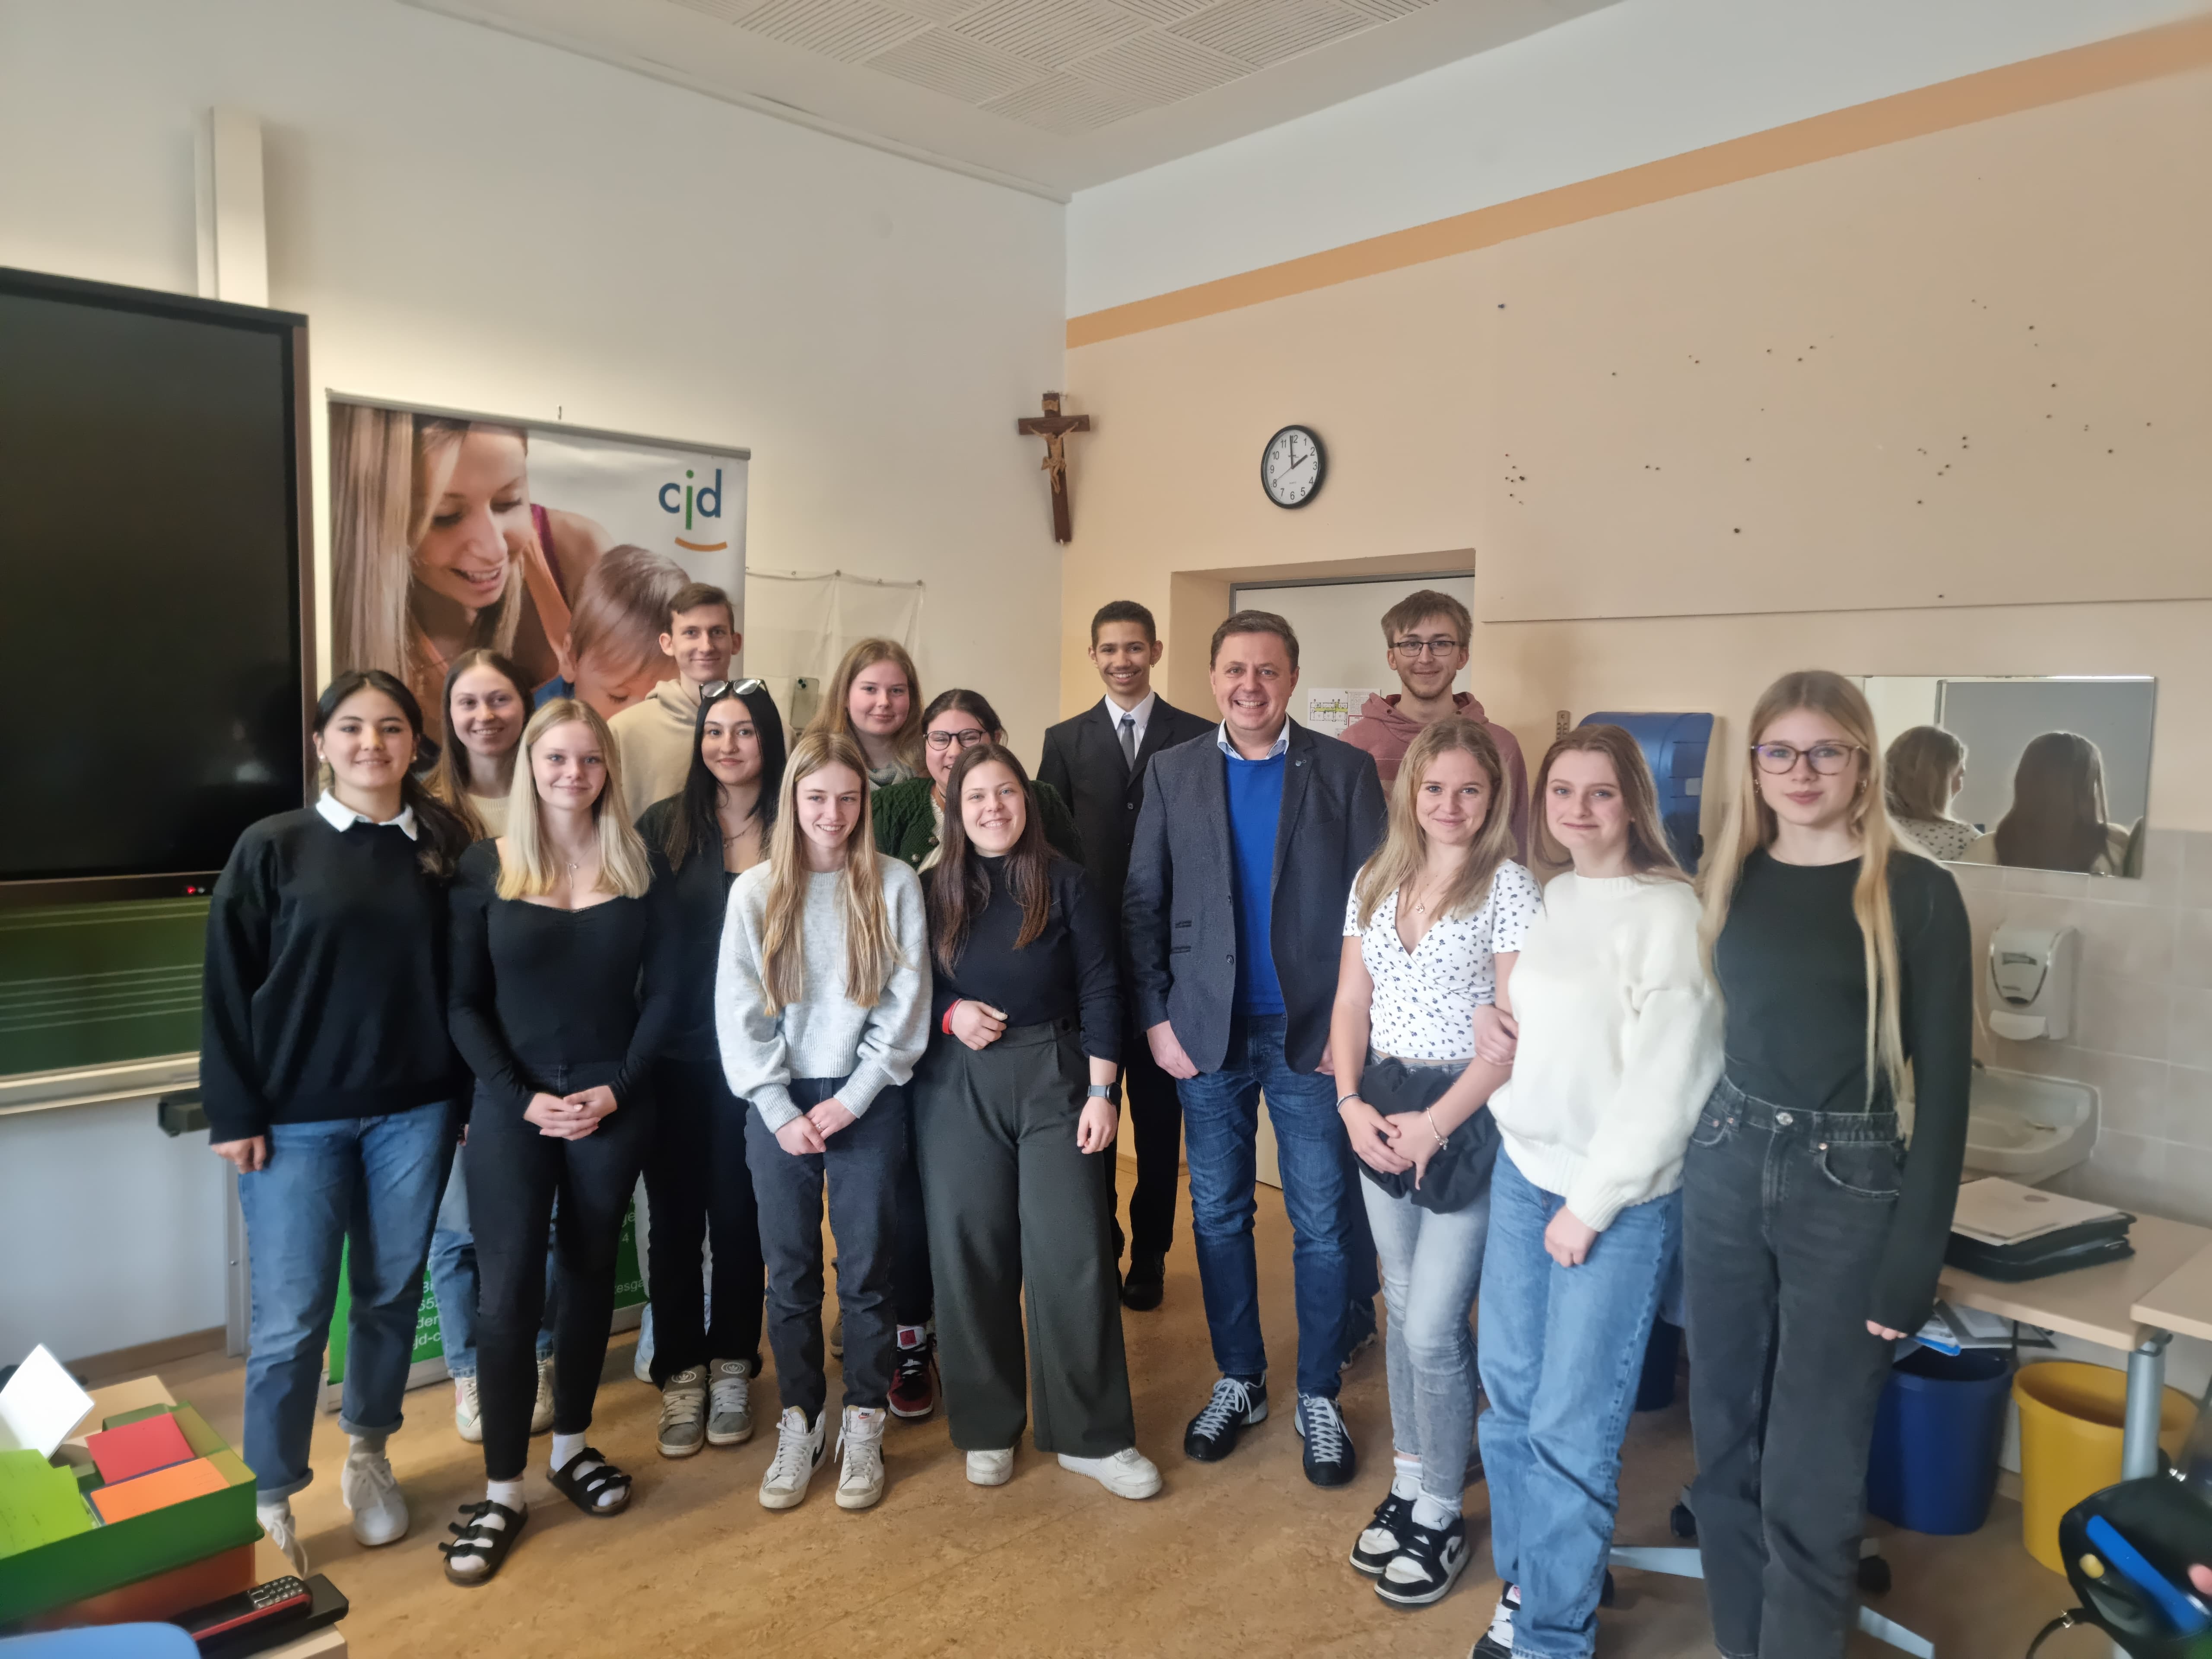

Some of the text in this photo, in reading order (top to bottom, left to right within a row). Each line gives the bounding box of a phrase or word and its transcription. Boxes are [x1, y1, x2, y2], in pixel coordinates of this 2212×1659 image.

[1281, 439, 1287, 448] 11
[1290, 435, 1298, 443] 12
[1303, 438, 1307, 446] 1
[1272, 451, 1280, 460] 10
[1310, 447, 1316, 456] 2
[1270, 465, 1274, 474] 9
[1313, 461, 1317, 470] 3
[1273, 479, 1277, 488] 8
[1309, 476, 1314, 486] 4
[1280, 488, 1284, 497] 7
[1290, 491, 1295, 500] 6
[1300, 487, 1306, 496] 5
[658, 468, 721, 531] cjd
